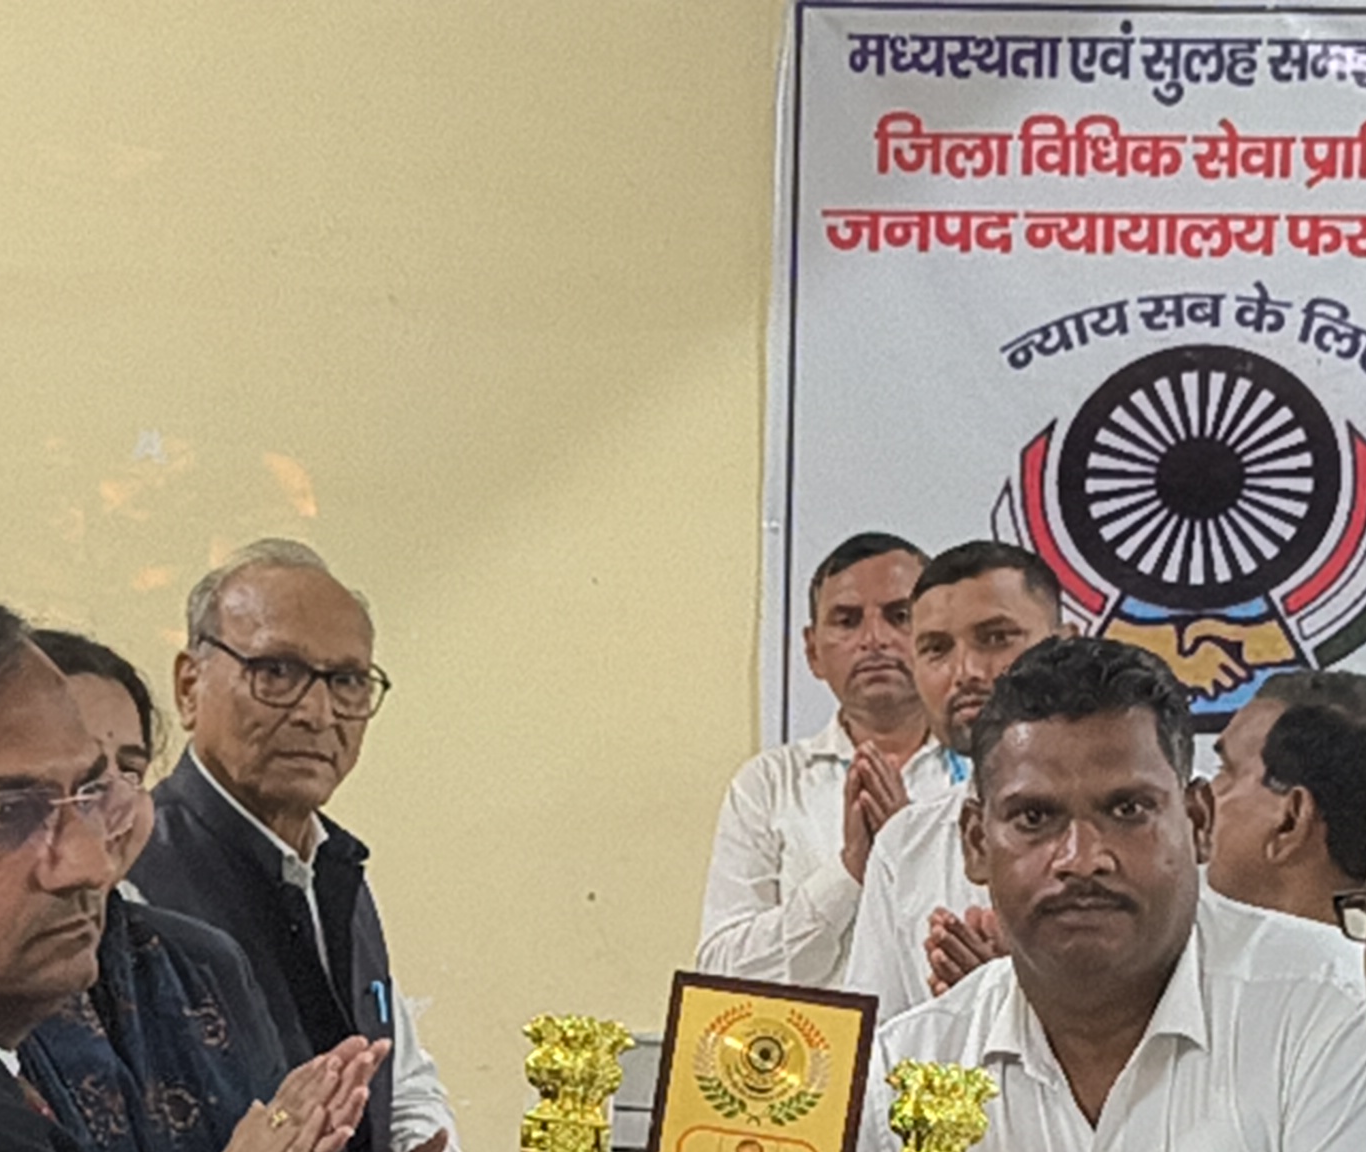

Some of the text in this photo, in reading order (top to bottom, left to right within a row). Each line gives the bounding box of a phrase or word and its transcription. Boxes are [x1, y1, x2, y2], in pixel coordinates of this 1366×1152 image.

[848, 33, 1062, 81] मध्यस्थता
[1068, 20, 1135, 82] एवं
[1140, 36, 1262, 106] सुलह
[874, 112, 1014, 179] जिला
[1018, 115, 1186, 178] विधिक
[1193, 118, 1296, 179] सेवा
[822, 209, 1018, 254] जनपद
[1023, 212, 1279, 258] न्यायालय
[1000, 299, 1130, 370] न्याय
[1137, 292, 1226, 332] सब
[1234, 281, 1293, 333] के
